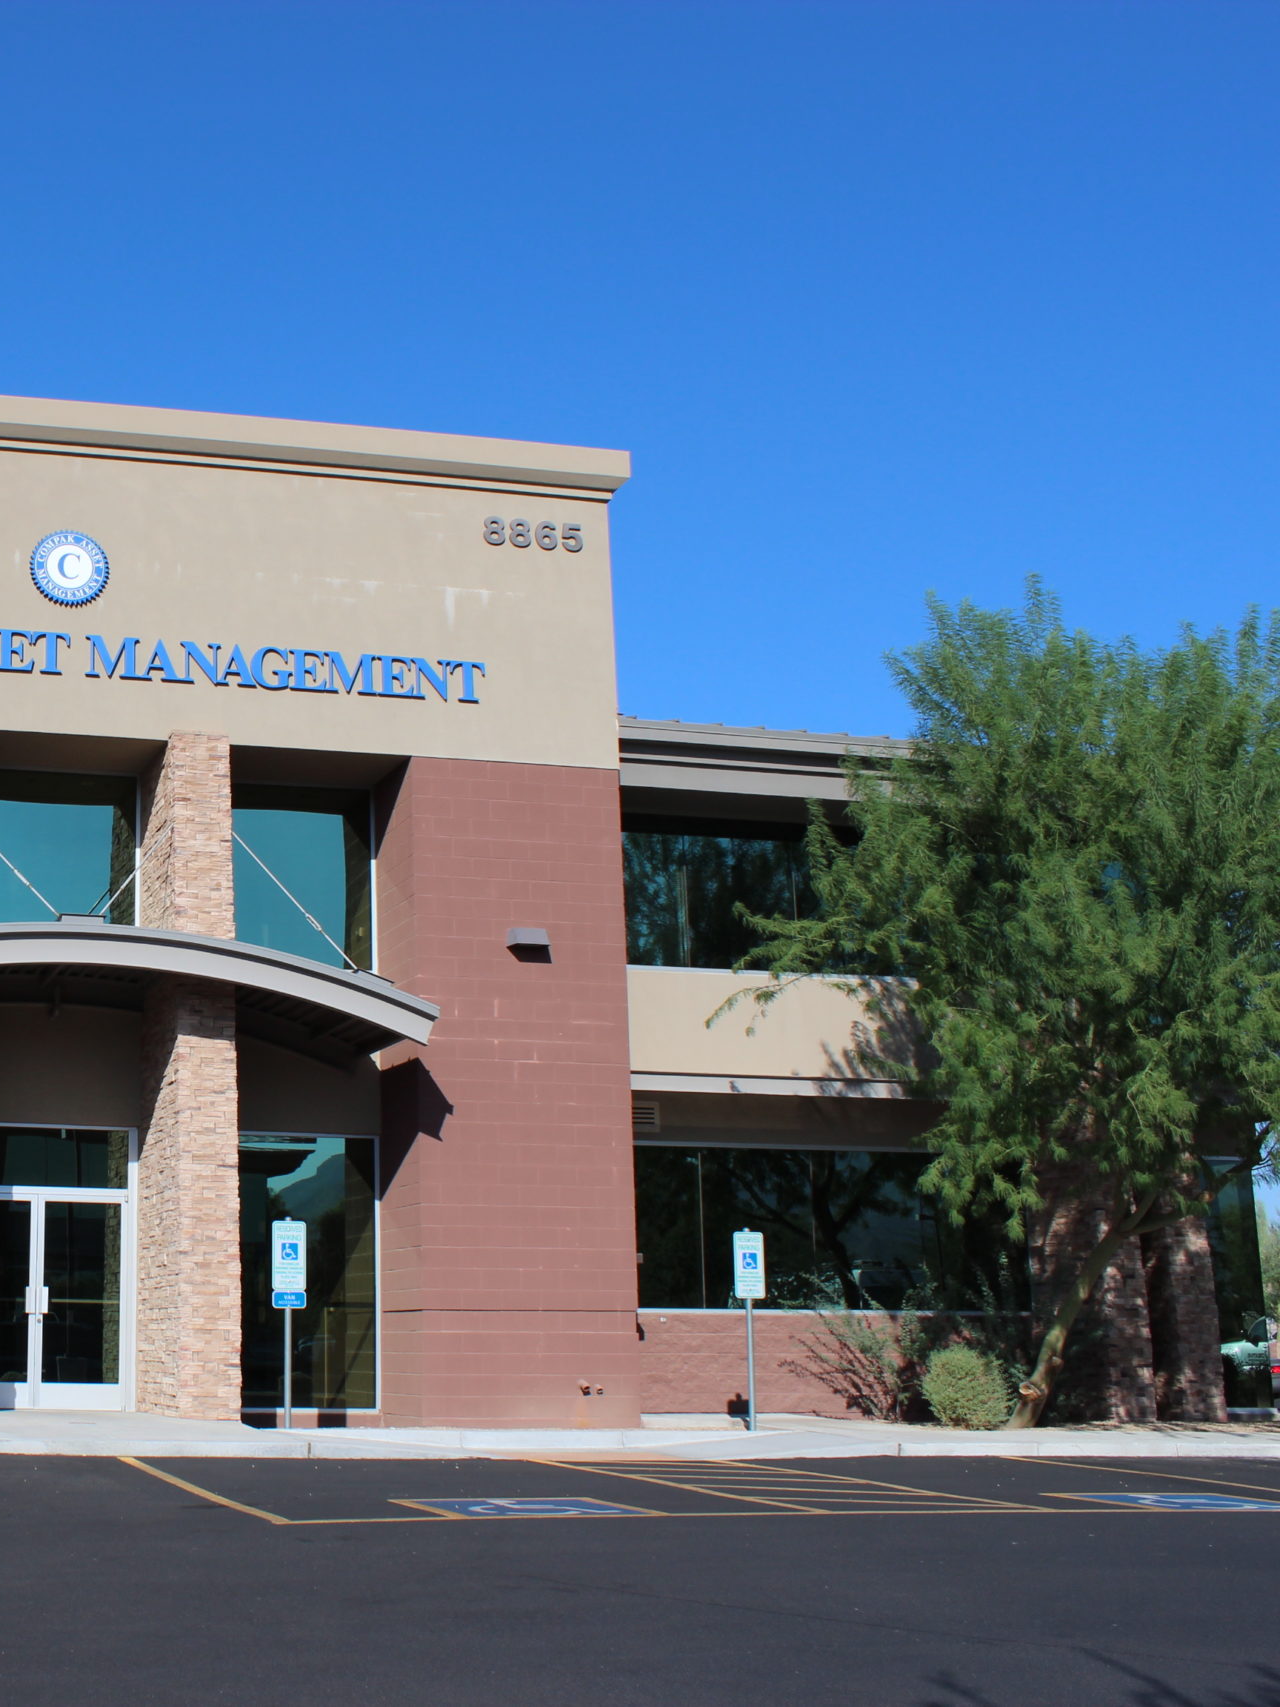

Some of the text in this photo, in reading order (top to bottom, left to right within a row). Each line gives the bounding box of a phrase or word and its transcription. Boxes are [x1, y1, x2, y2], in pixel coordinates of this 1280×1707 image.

[483, 516, 583, 553] 8865
[37, 535, 104, 567] COMPAK ASSET
[57, 553, 81, 580] C
[37, 569, 102, 599] MANAGEMENT
[85, 634, 486, 703] MANAGEMENT
